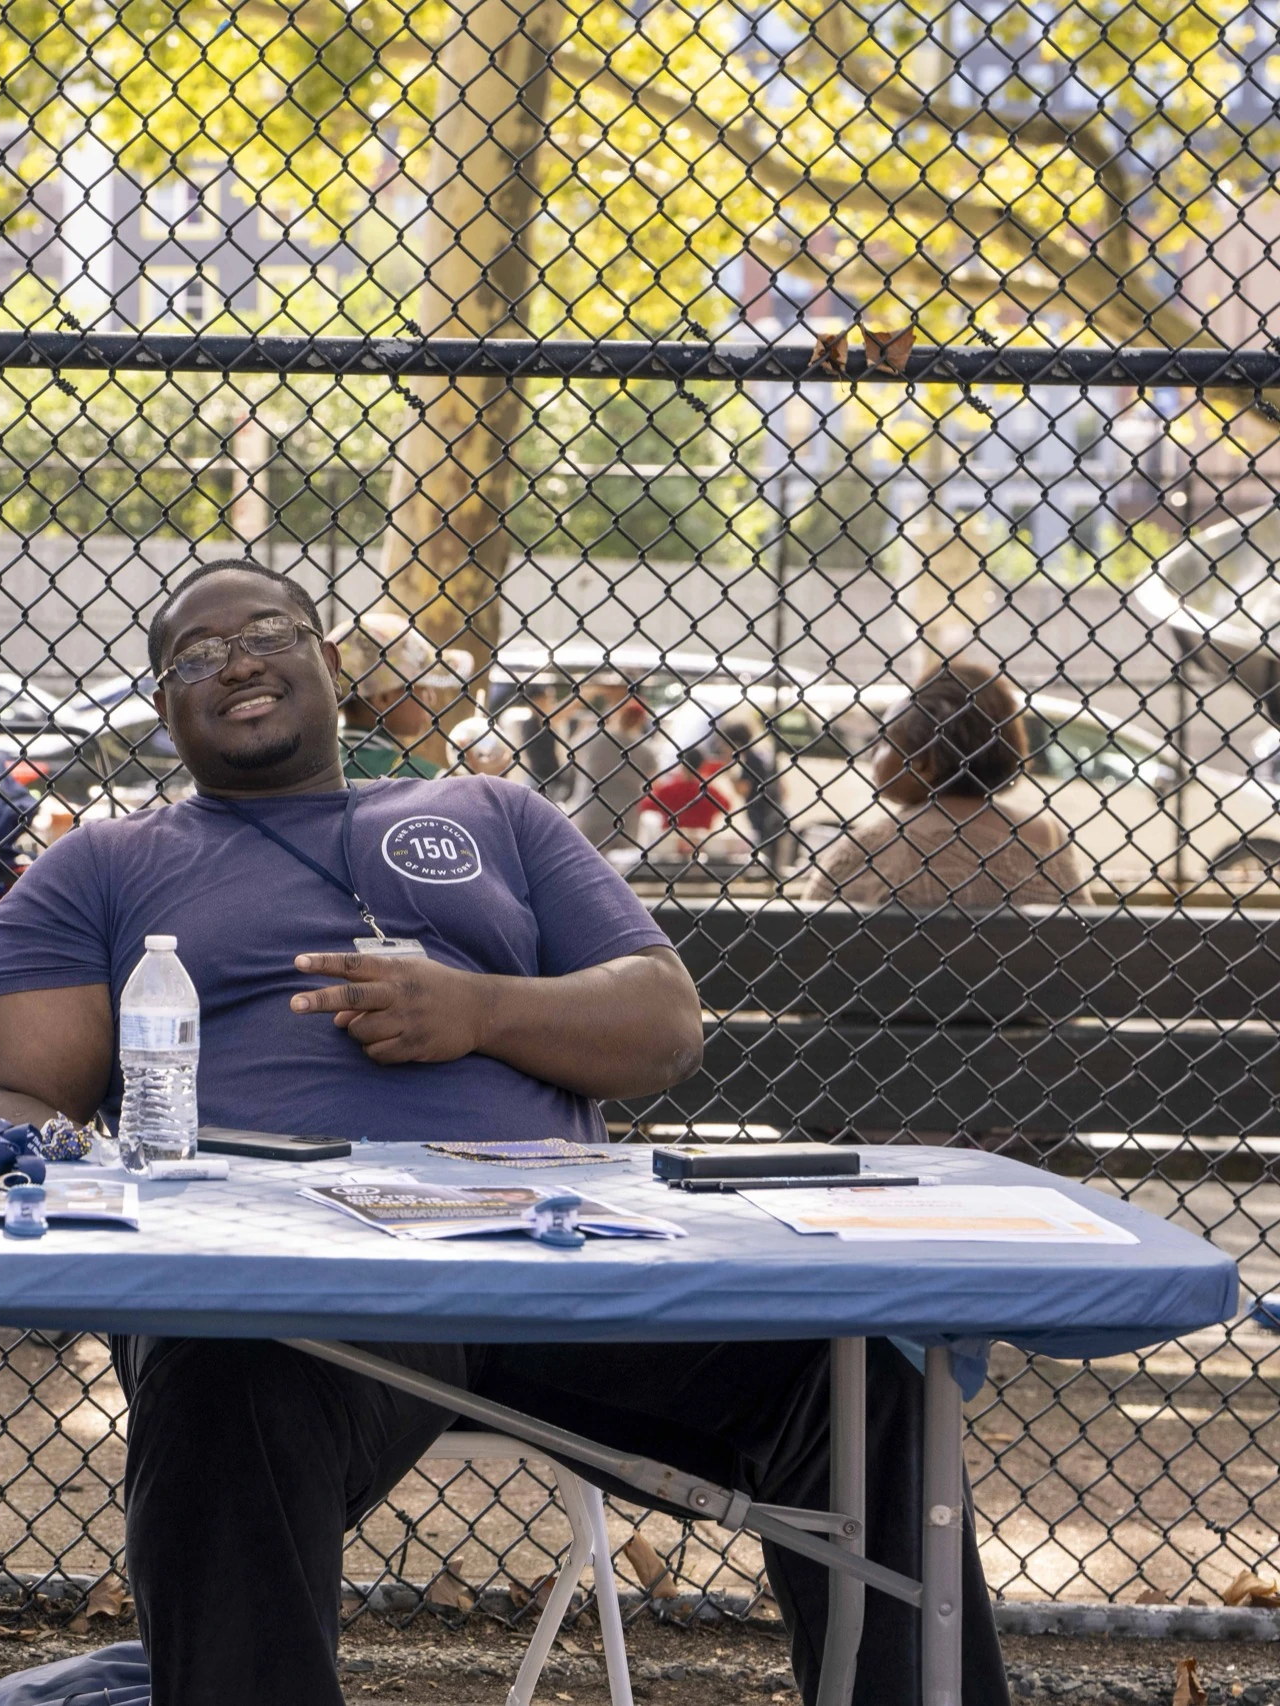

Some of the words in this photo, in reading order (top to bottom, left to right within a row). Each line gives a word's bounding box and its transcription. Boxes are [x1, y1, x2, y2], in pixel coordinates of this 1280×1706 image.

[394, 829, 408, 843] THE
[442, 826, 465, 842] CLUB
[409, 838, 457, 860] 150
[405, 861, 419, 870] OF
[450, 862, 472, 874] YORK
